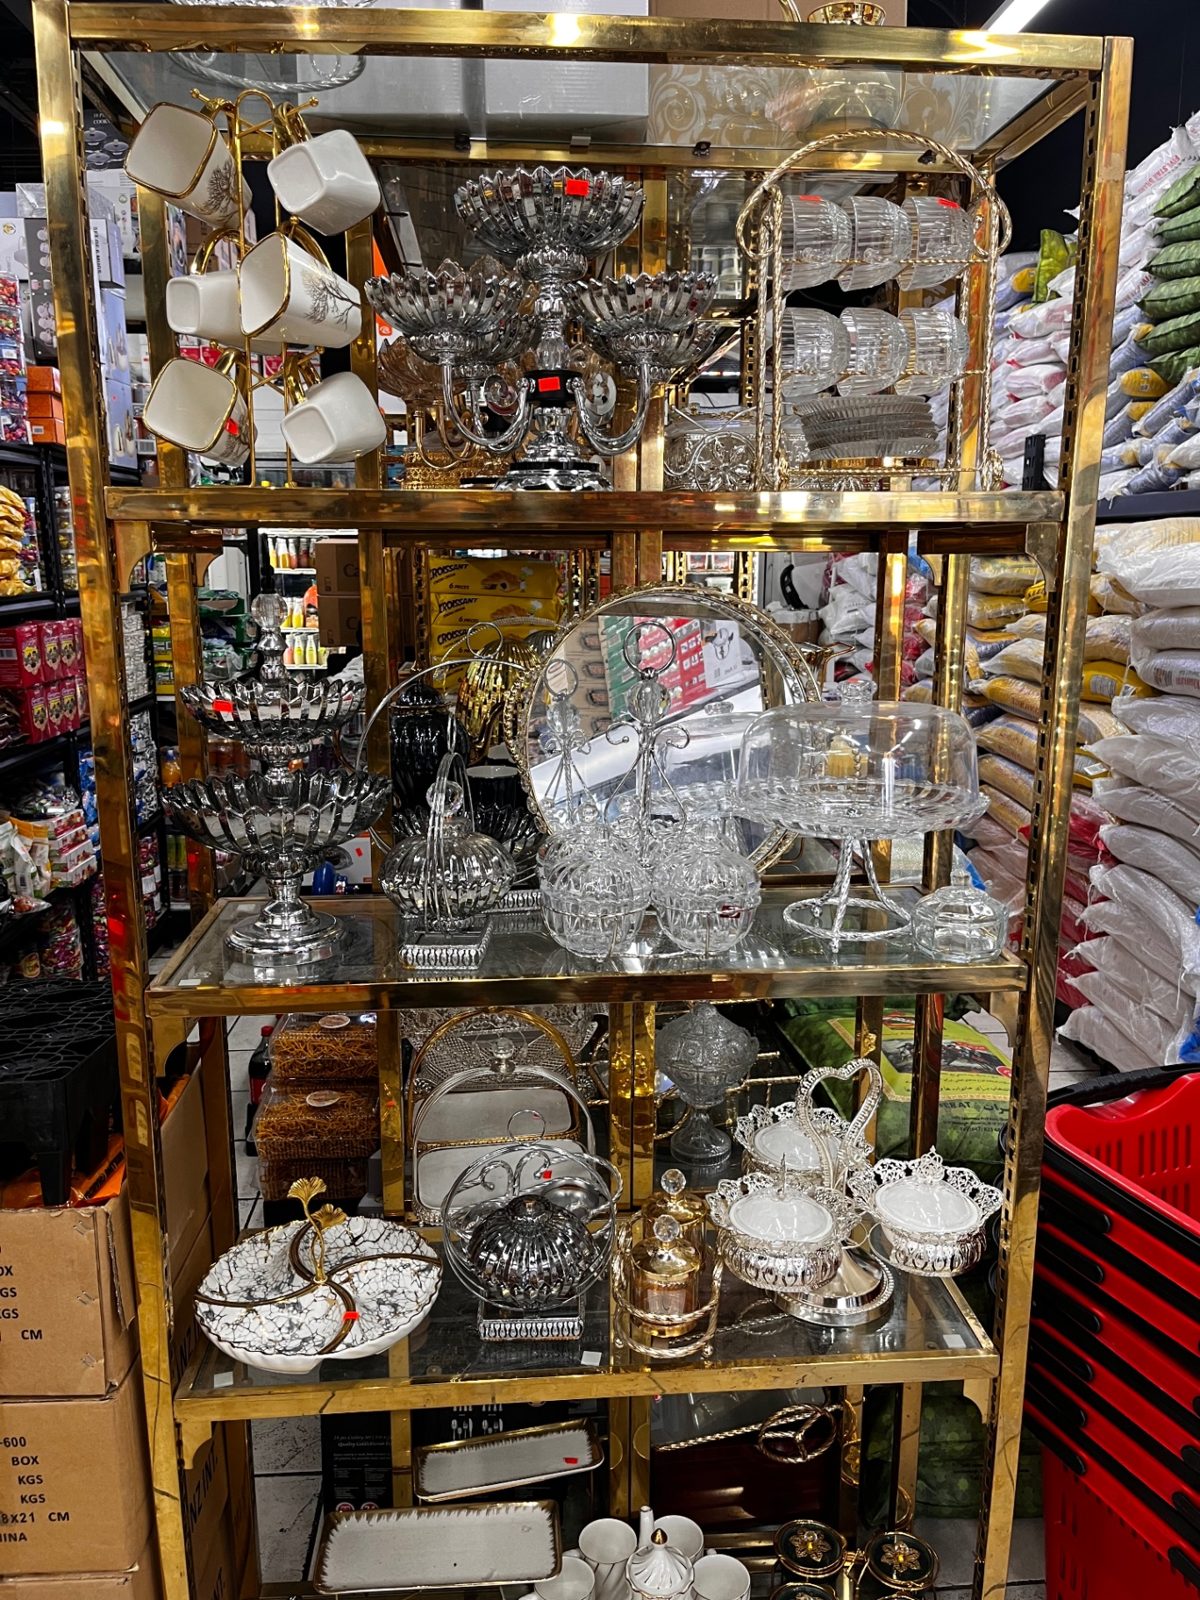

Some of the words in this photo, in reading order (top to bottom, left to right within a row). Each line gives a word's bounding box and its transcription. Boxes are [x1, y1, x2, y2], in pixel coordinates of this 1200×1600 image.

[21, 1329, 43, 1340] CM
[11, 1455, 40, 1466] BOX
[18, 1475, 44, 1485] KGS
[20, 1494, 46, 1504] KGS
[48, 1511, 70, 1522] CM
